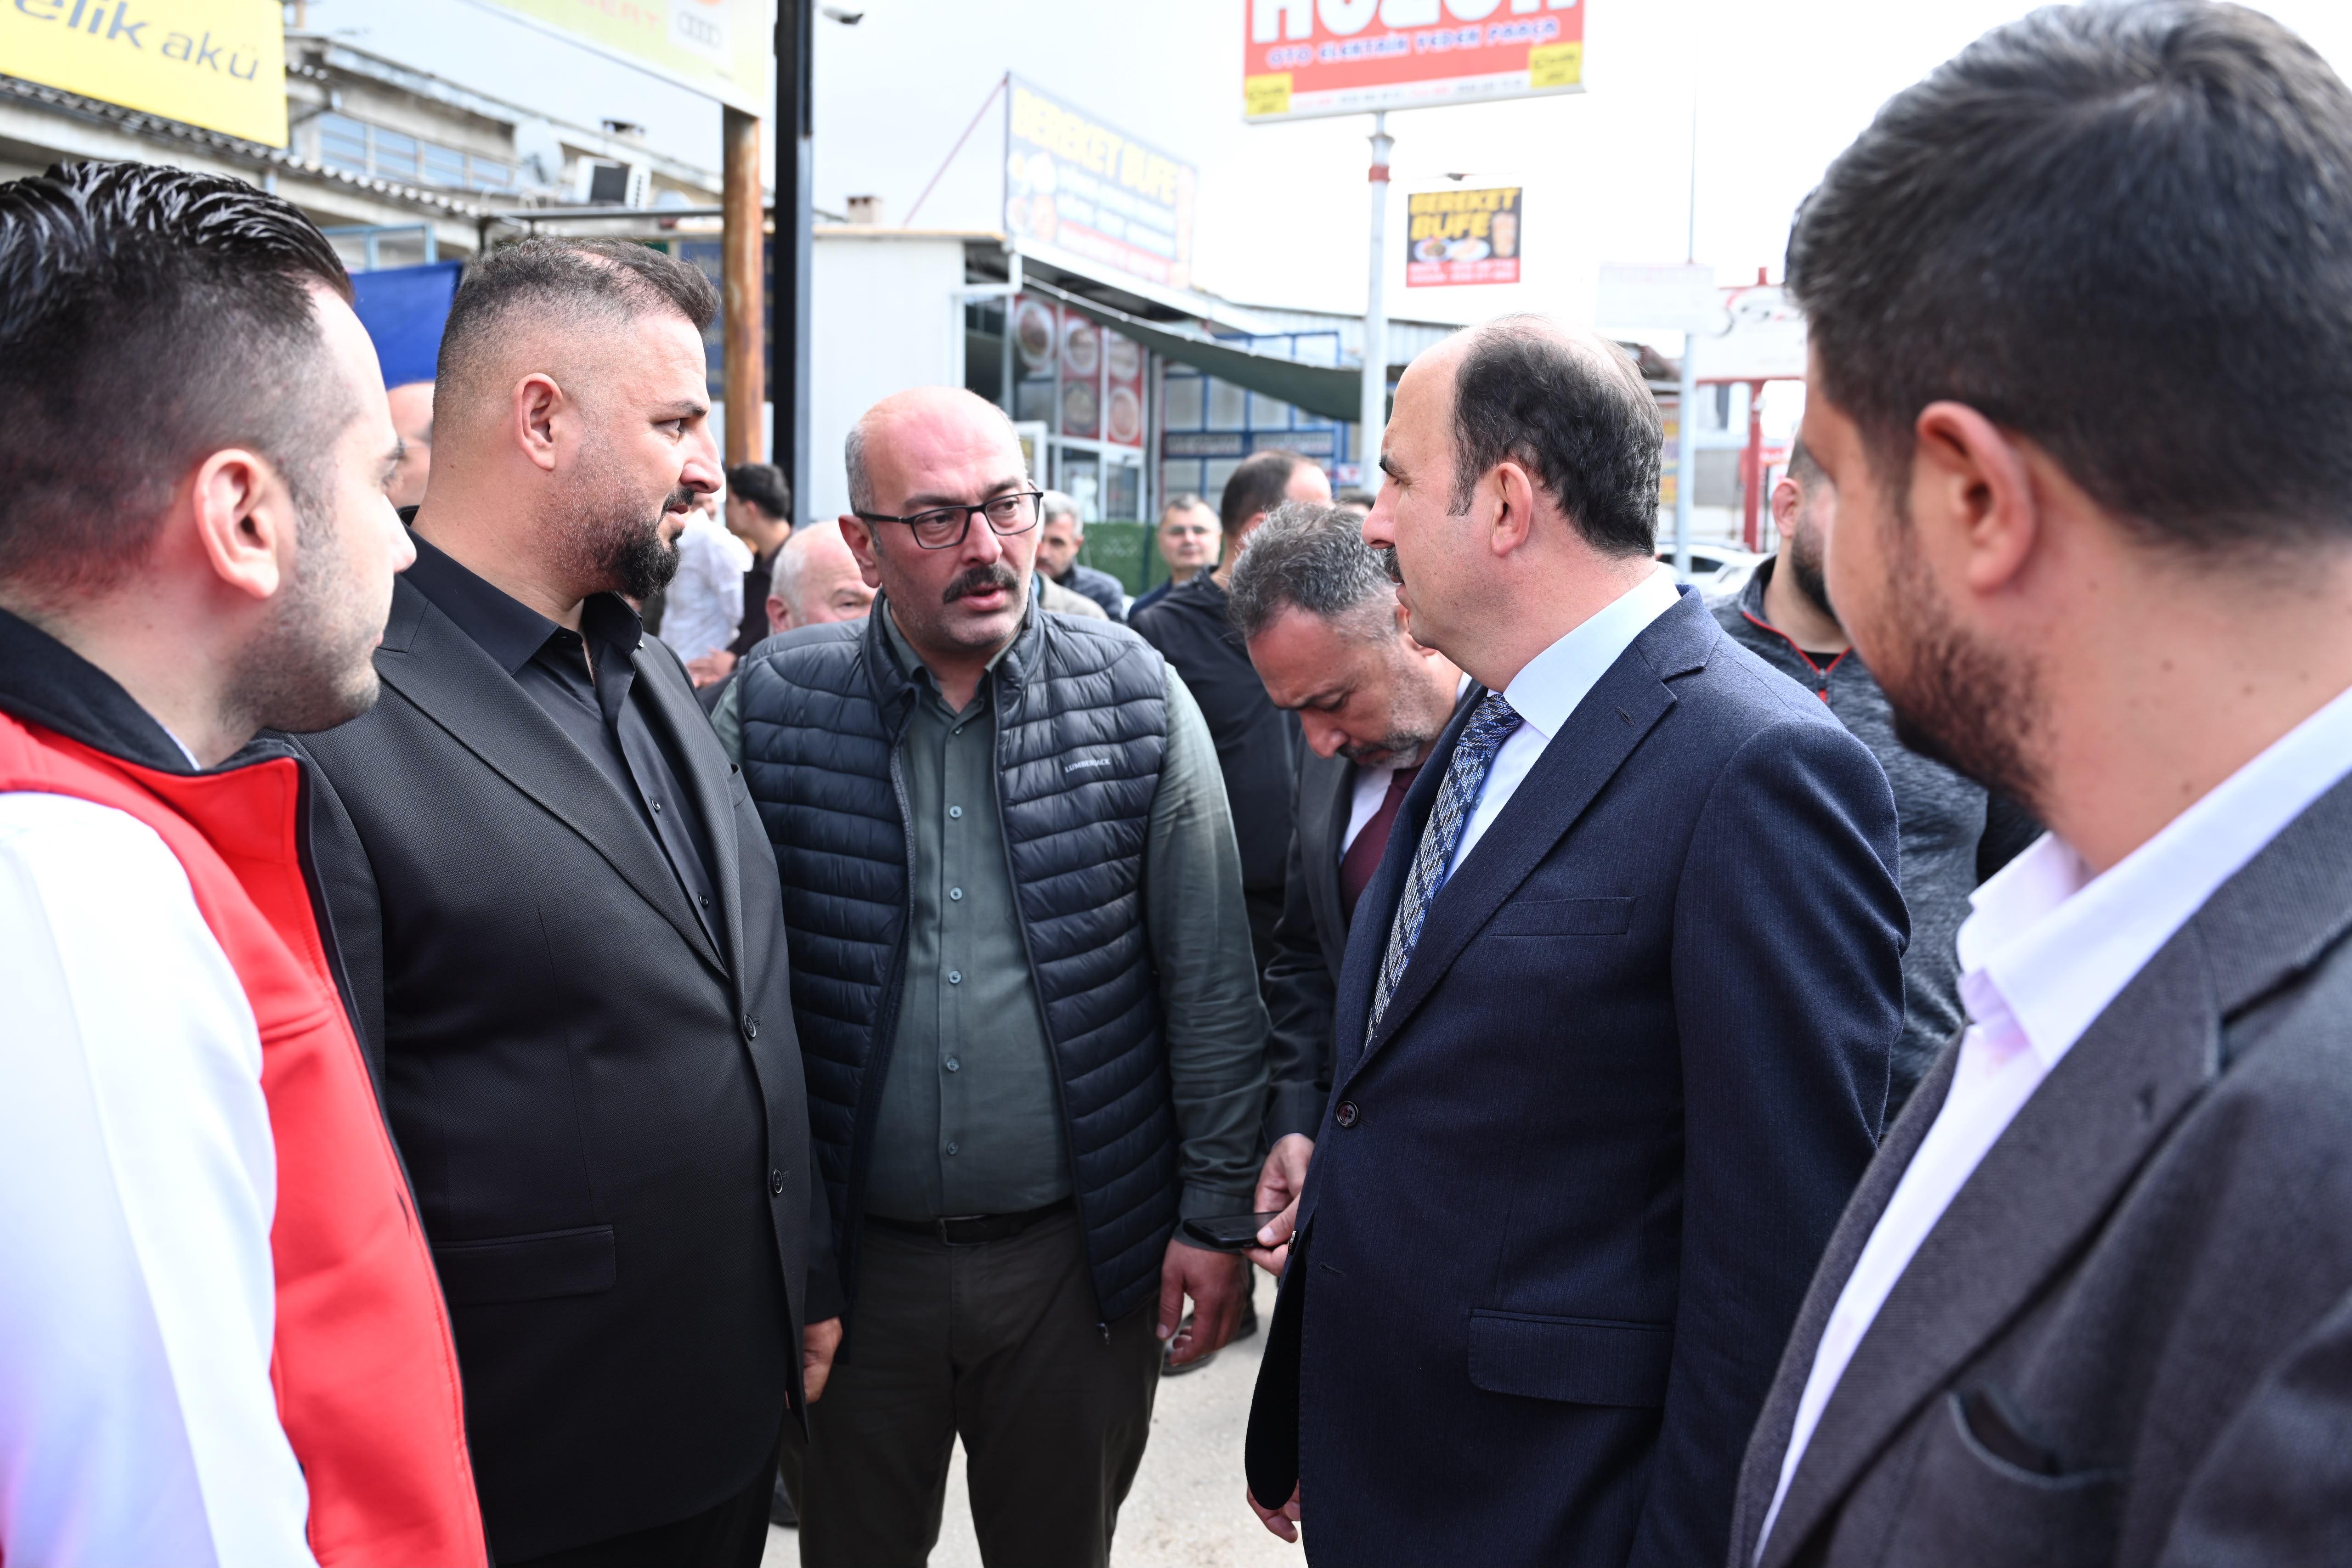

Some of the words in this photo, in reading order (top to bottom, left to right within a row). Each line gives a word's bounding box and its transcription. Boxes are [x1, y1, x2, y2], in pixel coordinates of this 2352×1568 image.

[161, 31, 258, 81] akü
[1267, 45, 1312, 67] OTO
[1416, 28, 1481, 53] YEDEK
[1410, 187, 1520, 215] BEREKET
[1064, 758, 1111, 773] LUMBERJACK
